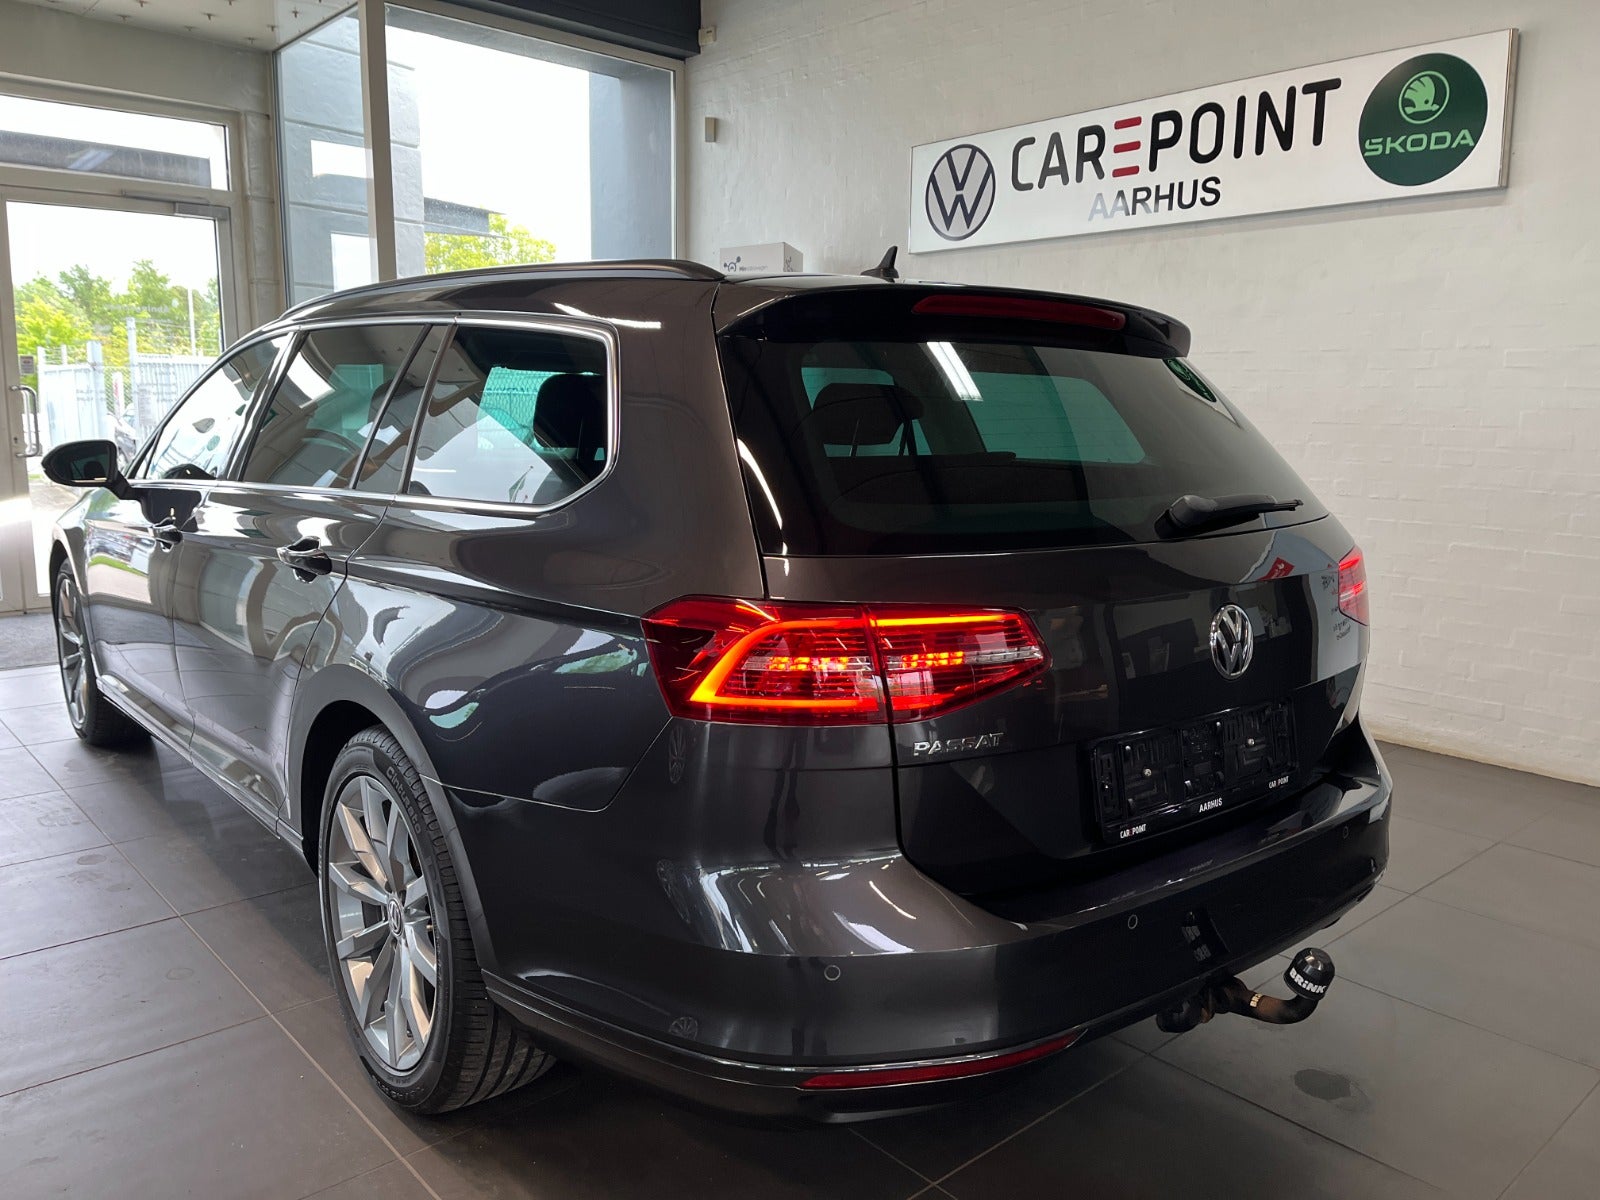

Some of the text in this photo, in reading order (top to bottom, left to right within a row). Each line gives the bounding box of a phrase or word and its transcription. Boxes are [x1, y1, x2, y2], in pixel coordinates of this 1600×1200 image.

[1088, 176, 1221, 222] AARHUS
[913, 732, 1004, 756] PASSAT
[1199, 797, 1222, 813] AARHUS
